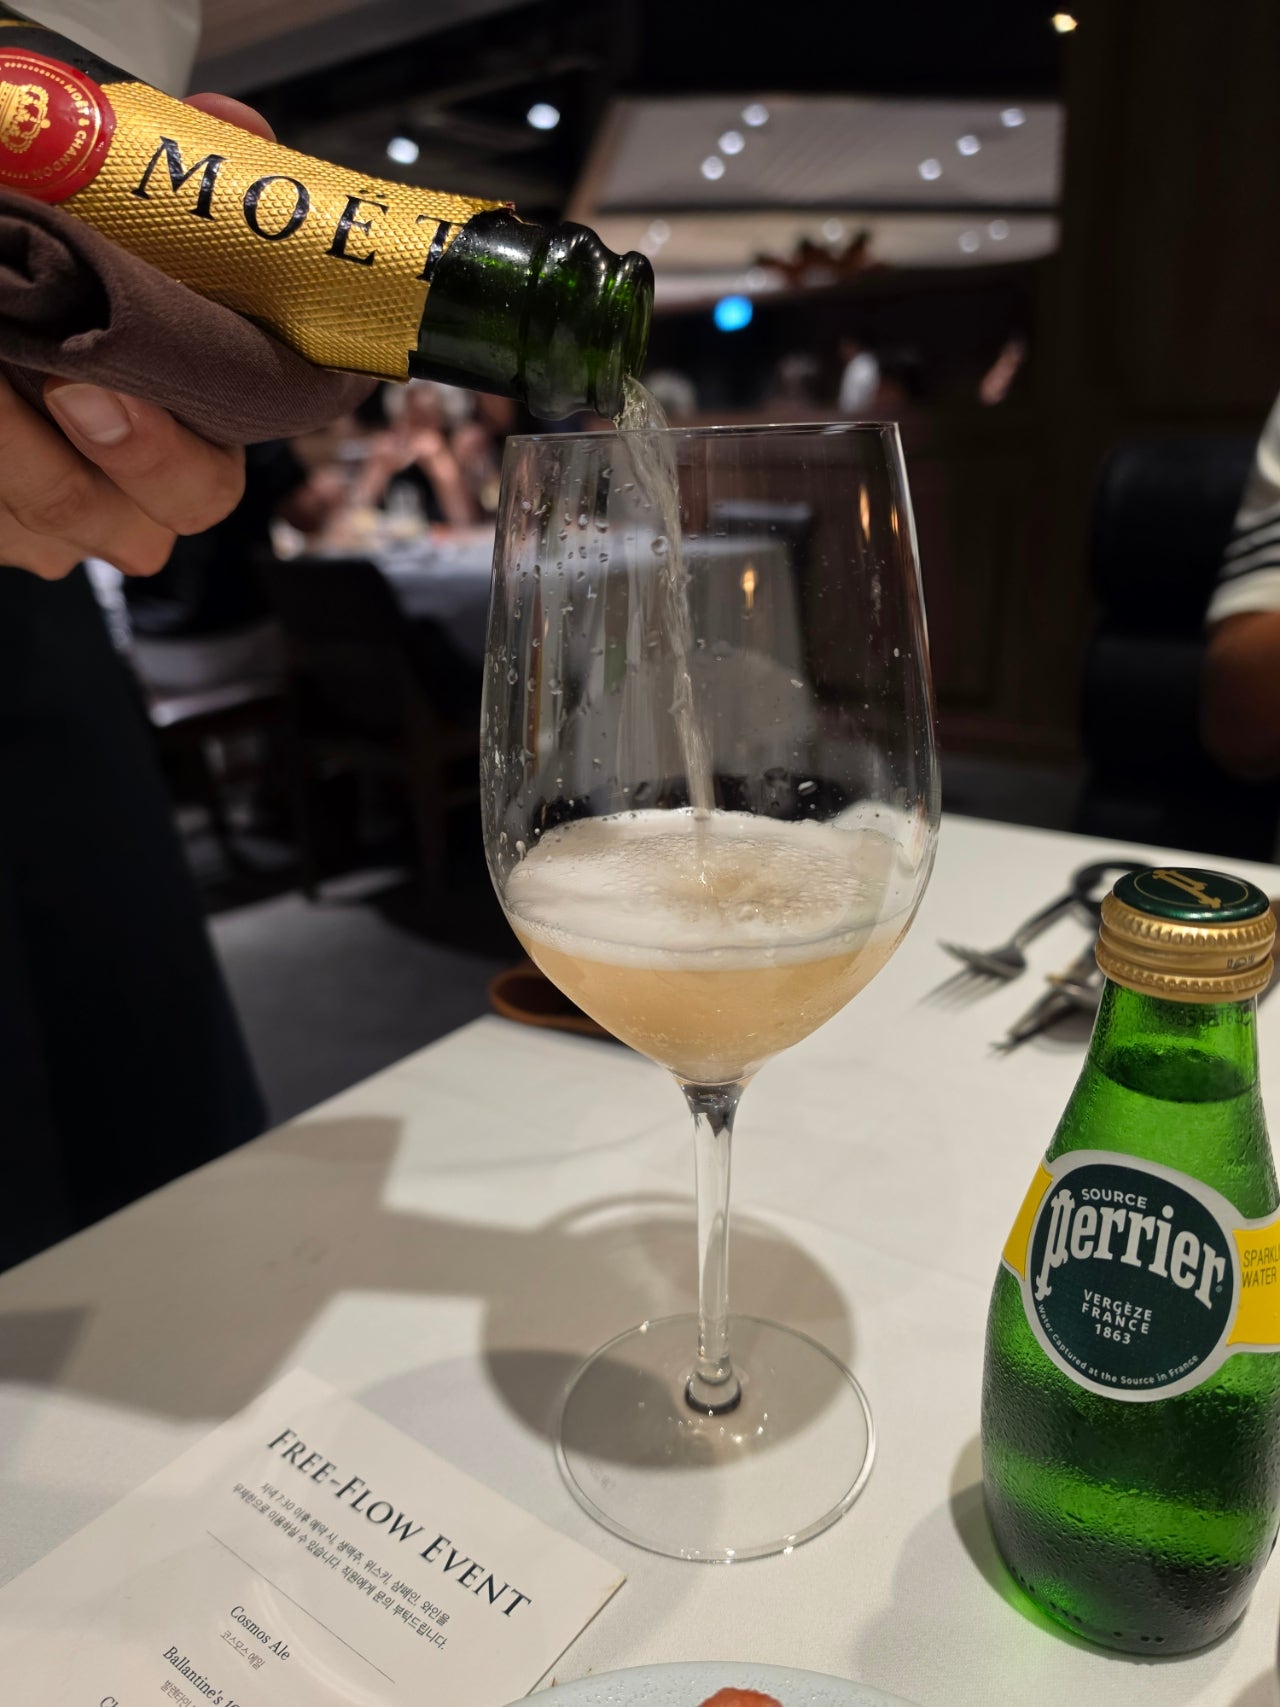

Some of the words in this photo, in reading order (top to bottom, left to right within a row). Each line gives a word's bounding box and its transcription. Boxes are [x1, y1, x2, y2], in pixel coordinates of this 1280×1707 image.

[1081, 1188, 1148, 1209] SOURCE
[1241, 1266, 1277, 1288] WATER
[1081, 1302, 1150, 1335] FRANCE
[1083, 1289, 1153, 1322] VERGÈZE
[1037, 1303, 1053, 1334] Water
[1052, 1333, 1087, 1370] Captured
[1088, 1365, 1099, 1377] at
[1100, 1370, 1118, 1383] the
[1120, 1375, 1155, 1385] Source
[1156, 1371, 1168, 1383] in
[1168, 1354, 1200, 1377] France
[1094, 1322, 1132, 1345] 1863
[267, 1510, 300, 1538] 이용하실
[298, 1534, 308, 1543] 수
[341, 1565, 377, 1596] 직원에게
[372, 1590, 396, 1610] 문의
[392, 1604, 448, 1650] 부탁드립니다.
[309, 1519, 329, 1535] 예약
[420, 1600, 451, 1627] 와인을
[220, 1630, 250, 1657] 코스모스
[247, 1651, 266, 1671] 에일
[230, 1605, 272, 1644] Cosmos
[268, 1640, 291, 1661] Ale
[163, 1646, 224, 1706] Ballantine's
